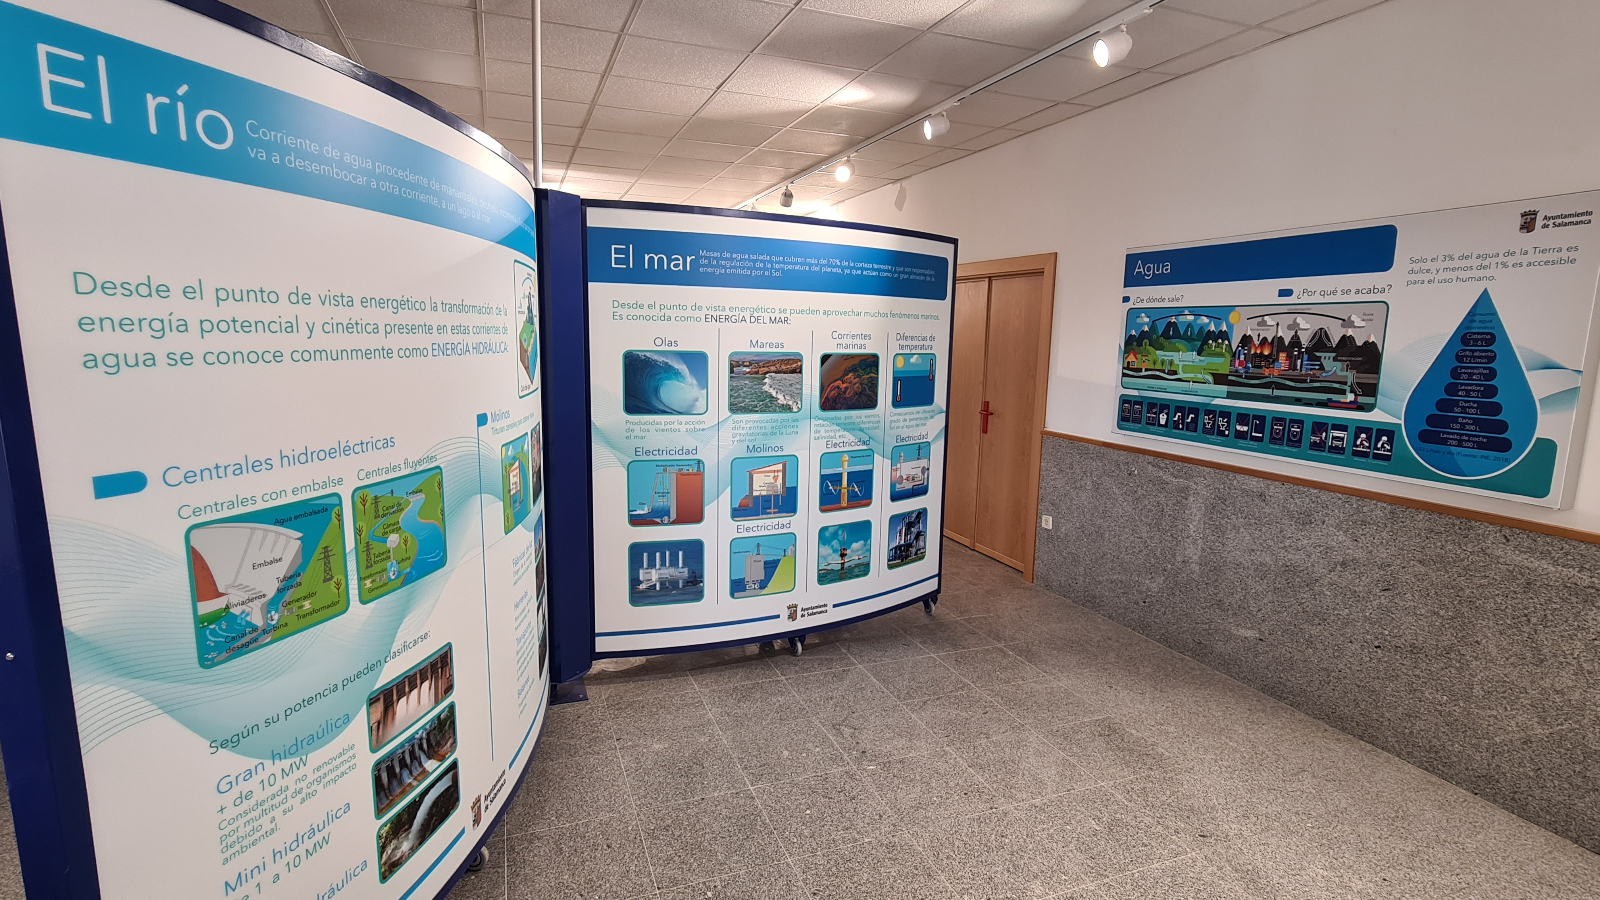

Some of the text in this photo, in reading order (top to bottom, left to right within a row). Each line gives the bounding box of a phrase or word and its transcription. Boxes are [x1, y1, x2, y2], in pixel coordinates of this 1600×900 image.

[36, 42, 234, 150] El río
[246, 119, 428, 188] Corriente de agua procedente
[247, 146, 399, 195] va a desembocar otra
[1542, 210, 1594, 221] Ayuntamiento
[1552, 218, 1592, 228] Salamanca
[611, 244, 695, 272] El mar
[699, 250, 806, 264] Masas de agua salada cubren
[1409, 256, 1428, 265] Solo
[1430, 255, 1439, 263] el
[1441, 254, 1455, 262] 3%
[1458, 252, 1473, 261] del
[1475, 252, 1500, 262] agua
[1503, 249, 1517, 258] de
[1520, 247, 1529, 256] la
[1532, 246, 1562, 255] Tierra
[699, 265, 751, 275] energía emitida
[1133, 259, 1172, 279] Agua
[1407, 256, 1577, 275] dulce, menos del 1% es accesible
[1406, 273, 1497, 287] para el uso humano.
[72, 271, 494, 316] Desde el punto de vista energético la transformación
[1132, 295, 1184, 306] ¿De dónde sale?
[1296, 284, 1392, 300] ¿Por qué se acaba?
[612, 300, 645, 311] Desde
[647, 301, 656, 310] el
[659, 302, 688, 314] punto
[690, 302, 703, 312] de
[705, 303, 726, 313] vista
[728, 304, 776, 315] energético
[778, 306, 788, 314] se
[789, 306, 821, 317] pueden
[822, 308, 862, 318] aprovechar
[863, 310, 889, 319] muchos
[612, 312, 791, 326] Es conocida como ENERGÍA DEL MAR:
[78, 312, 471, 340] energía potencial y cinética presente en estas
[831, 330, 872, 341] Corrientes
[653, 336, 679, 347] Olas
[749, 339, 785, 349] Mareas
[836, 341, 867, 350] marinas
[895, 332, 928, 342] Diferencias
[898, 343, 933, 352] temperatura
[82, 341, 471, 375] agua se conoce comunmente como ENERGÍA
[825, 437, 871, 449] Electricidad
[895, 431, 929, 443] Electricidad
[634, 446, 698, 457] Electricidad
[746, 443, 785, 454] Molinos
[162, 435, 396, 488] Centrales hidroeléctricas
[357, 453, 438, 482] Centrales fluyentes
[177, 475, 344, 520] Centrales con embalse
[293, 506, 329, 521] embalsada
[736, 520, 792, 534] Electricidad
[252, 555, 283, 571] Embalse
[276, 580, 303, 595] forzada
[223, 592, 267, 611] Aliviaderos
[281, 590, 318, 608] Generador
[295, 599, 341, 621] Transformador
[224, 629, 247, 644] Canal
[261, 621, 288, 636] Turbina
[225, 636, 259, 655] desagüe
[209, 630, 431, 755] Según su potencia pueden clasificarse:
[216, 761, 265, 795] Gran
[218, 743, 356, 831] Considerada renovable
[233, 753, 309, 808] de 10 MW
[219, 752, 357, 846] por multitud organismos
[220, 762, 357, 854] debido impacto
[221, 823, 281, 866] ambiental.
[224, 801, 351, 897] Mini hidráulica
[305, 832, 331, 860] MW
